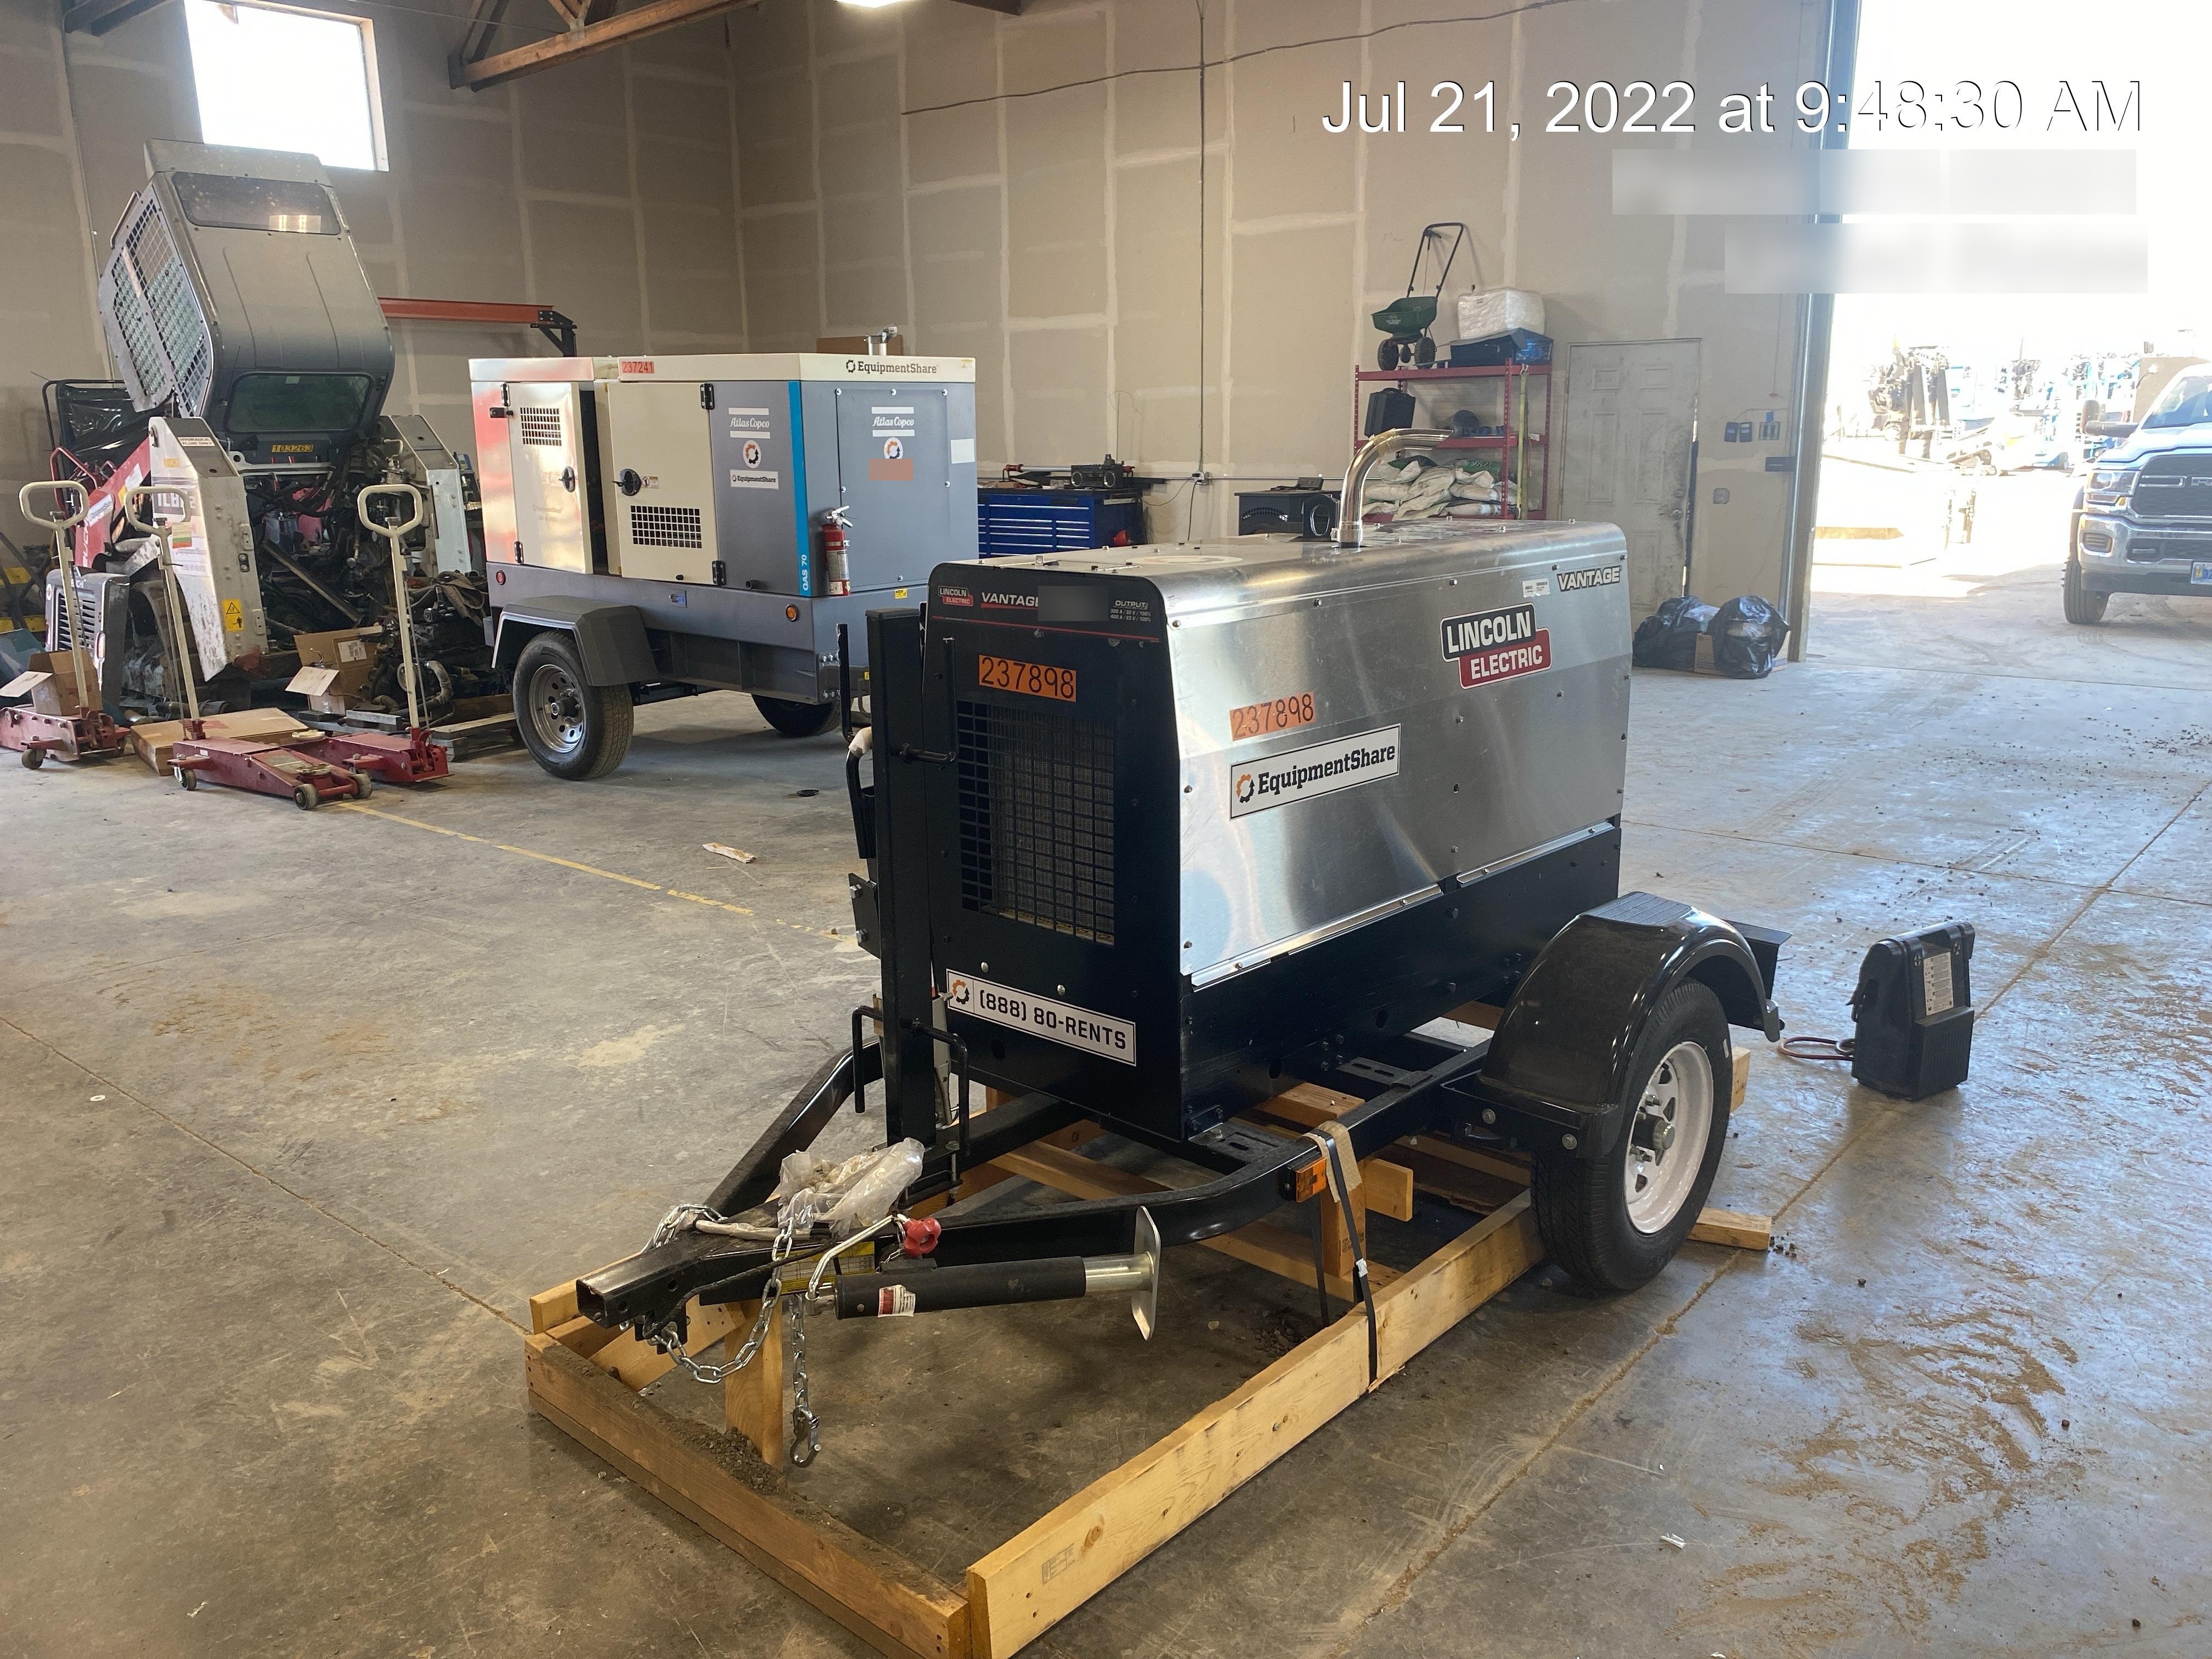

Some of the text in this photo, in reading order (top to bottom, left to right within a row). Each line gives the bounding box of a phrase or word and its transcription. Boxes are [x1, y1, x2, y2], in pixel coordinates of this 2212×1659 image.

[622, 361, 653, 373] 237241
[857, 361, 938, 375] EquipmentShare
[737, 475, 776, 483] EquipmentShare
[802, 554, 808, 567] 70
[1557, 566, 1621, 592] VANTAGE
[939, 588, 967, 597] LINCOLN
[981, 592, 1039, 607] VANTAG
[946, 596, 971, 605] ELECTRIC
[1115, 600, 1147, 608] OUTPUT
[1446, 611, 1532, 653] LINCOLN
[1470, 645, 1543, 680] ELECTRIC
[981, 657, 1074, 699] 237898
[1233, 693, 1314, 739] 237898
[1257, 745, 1396, 795] EquipmentShare
[979, 989, 1126, 1050] (888) 80-RENTS
